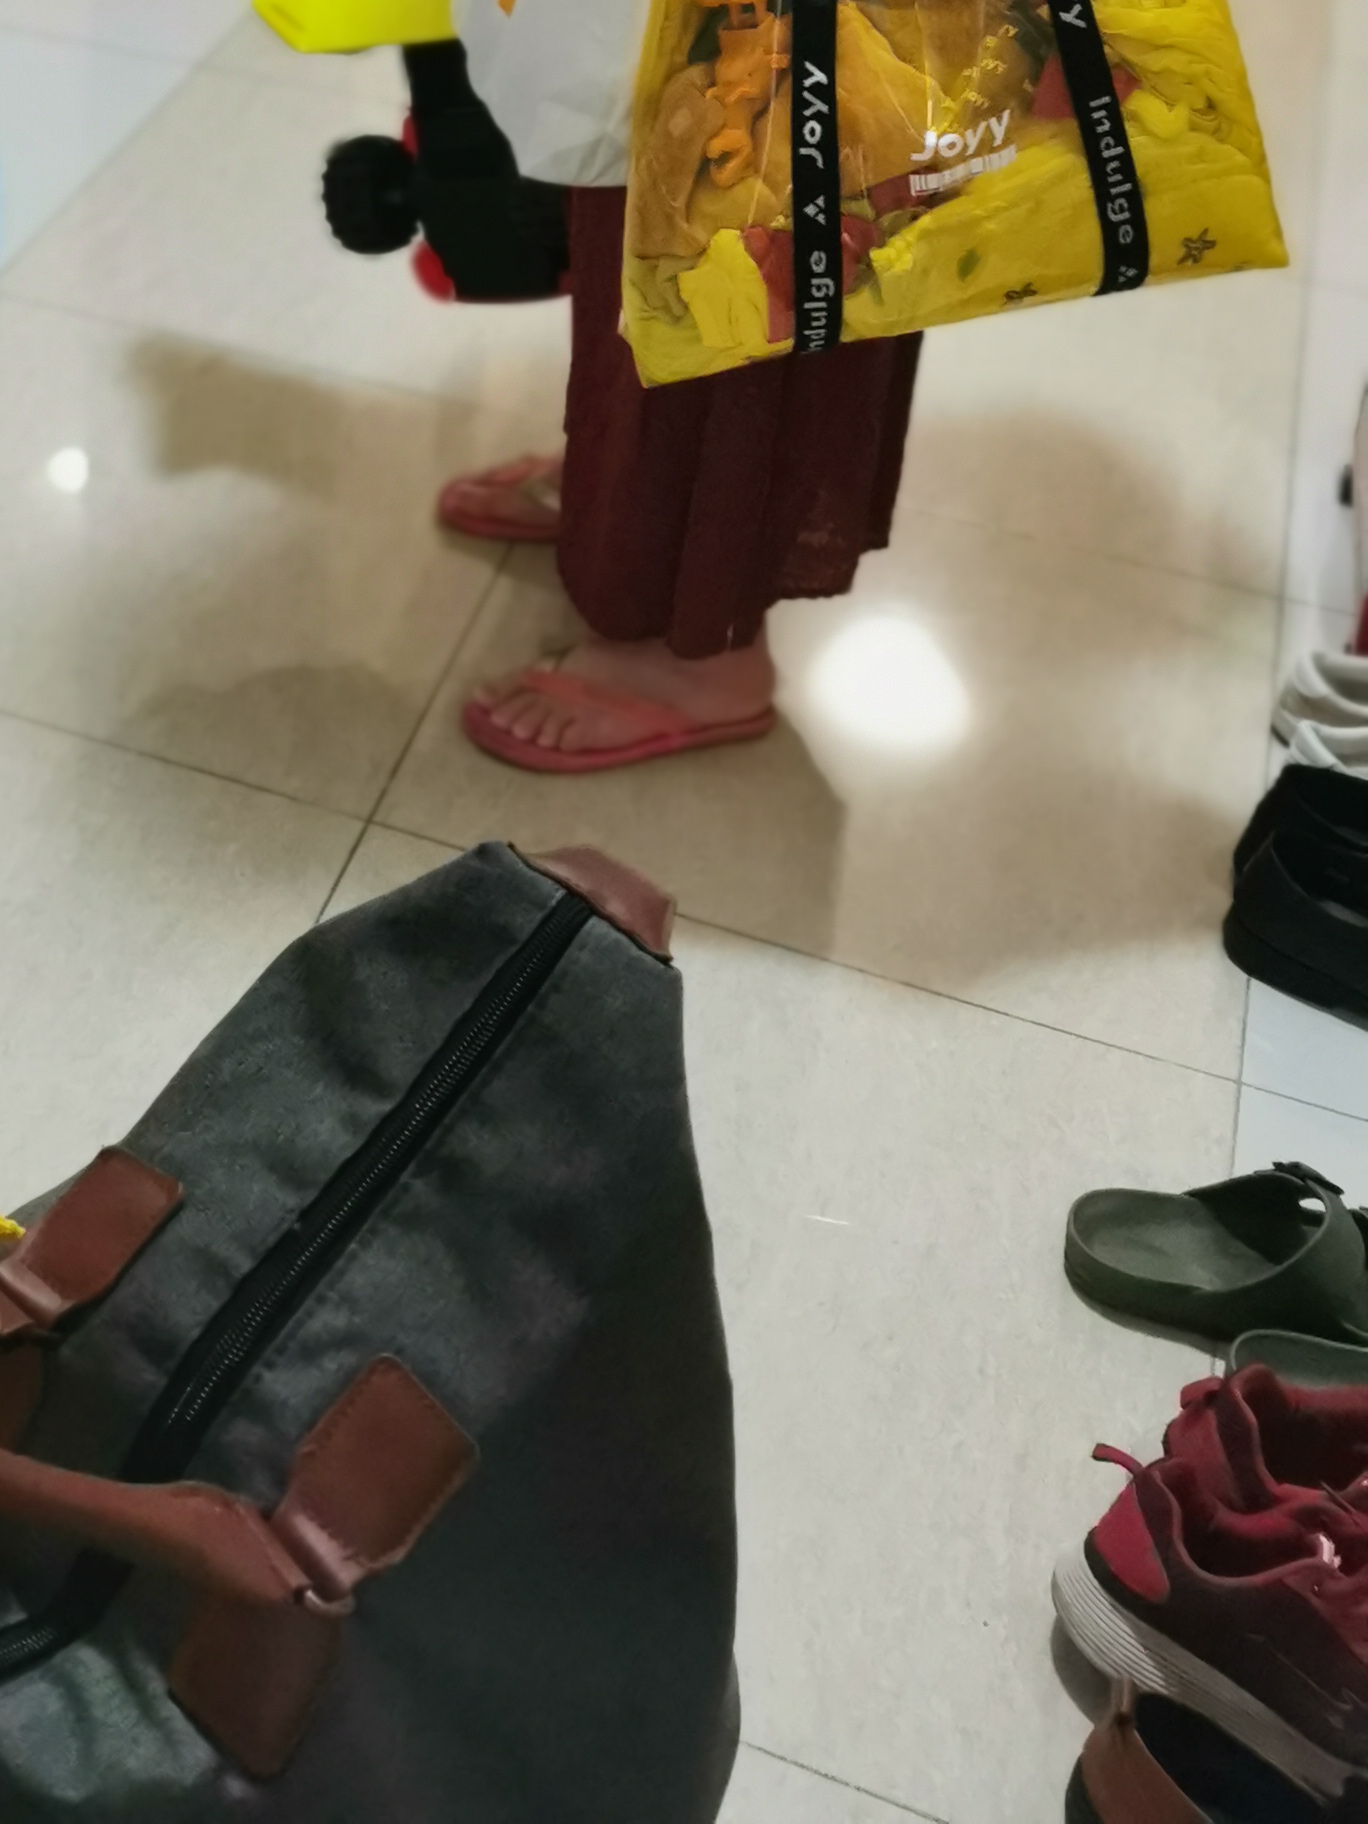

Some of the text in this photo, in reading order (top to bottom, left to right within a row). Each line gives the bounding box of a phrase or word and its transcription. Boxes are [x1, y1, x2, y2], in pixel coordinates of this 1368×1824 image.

[798, 59, 836, 352] ndulge Joyy
[909, 108, 1012, 163] Joyy
[1088, 94, 1135, 245] Indulge
